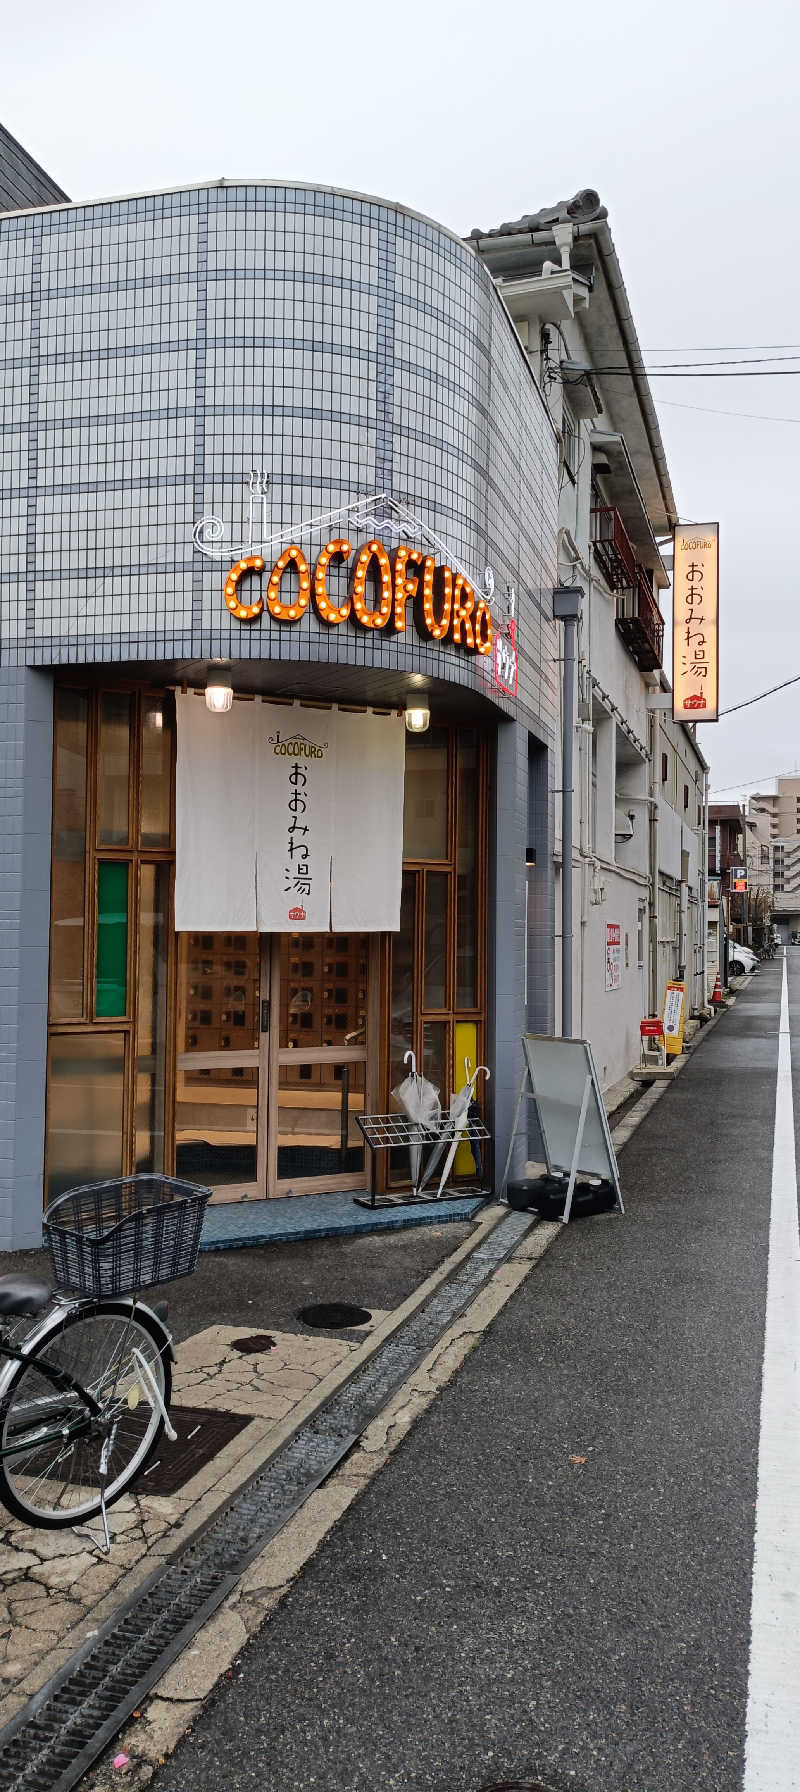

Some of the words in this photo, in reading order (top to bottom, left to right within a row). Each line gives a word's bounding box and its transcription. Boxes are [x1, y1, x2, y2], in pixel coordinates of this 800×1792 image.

[680, 539, 712, 551] COCOFURO
[224, 538, 493, 656] COCOFURO
[681, 562, 710, 679] おおみね湯
[273, 740, 324, 759] COCOFURO
[283, 762, 312, 896] おおみね湯
[736, 869, 745, 878] P
